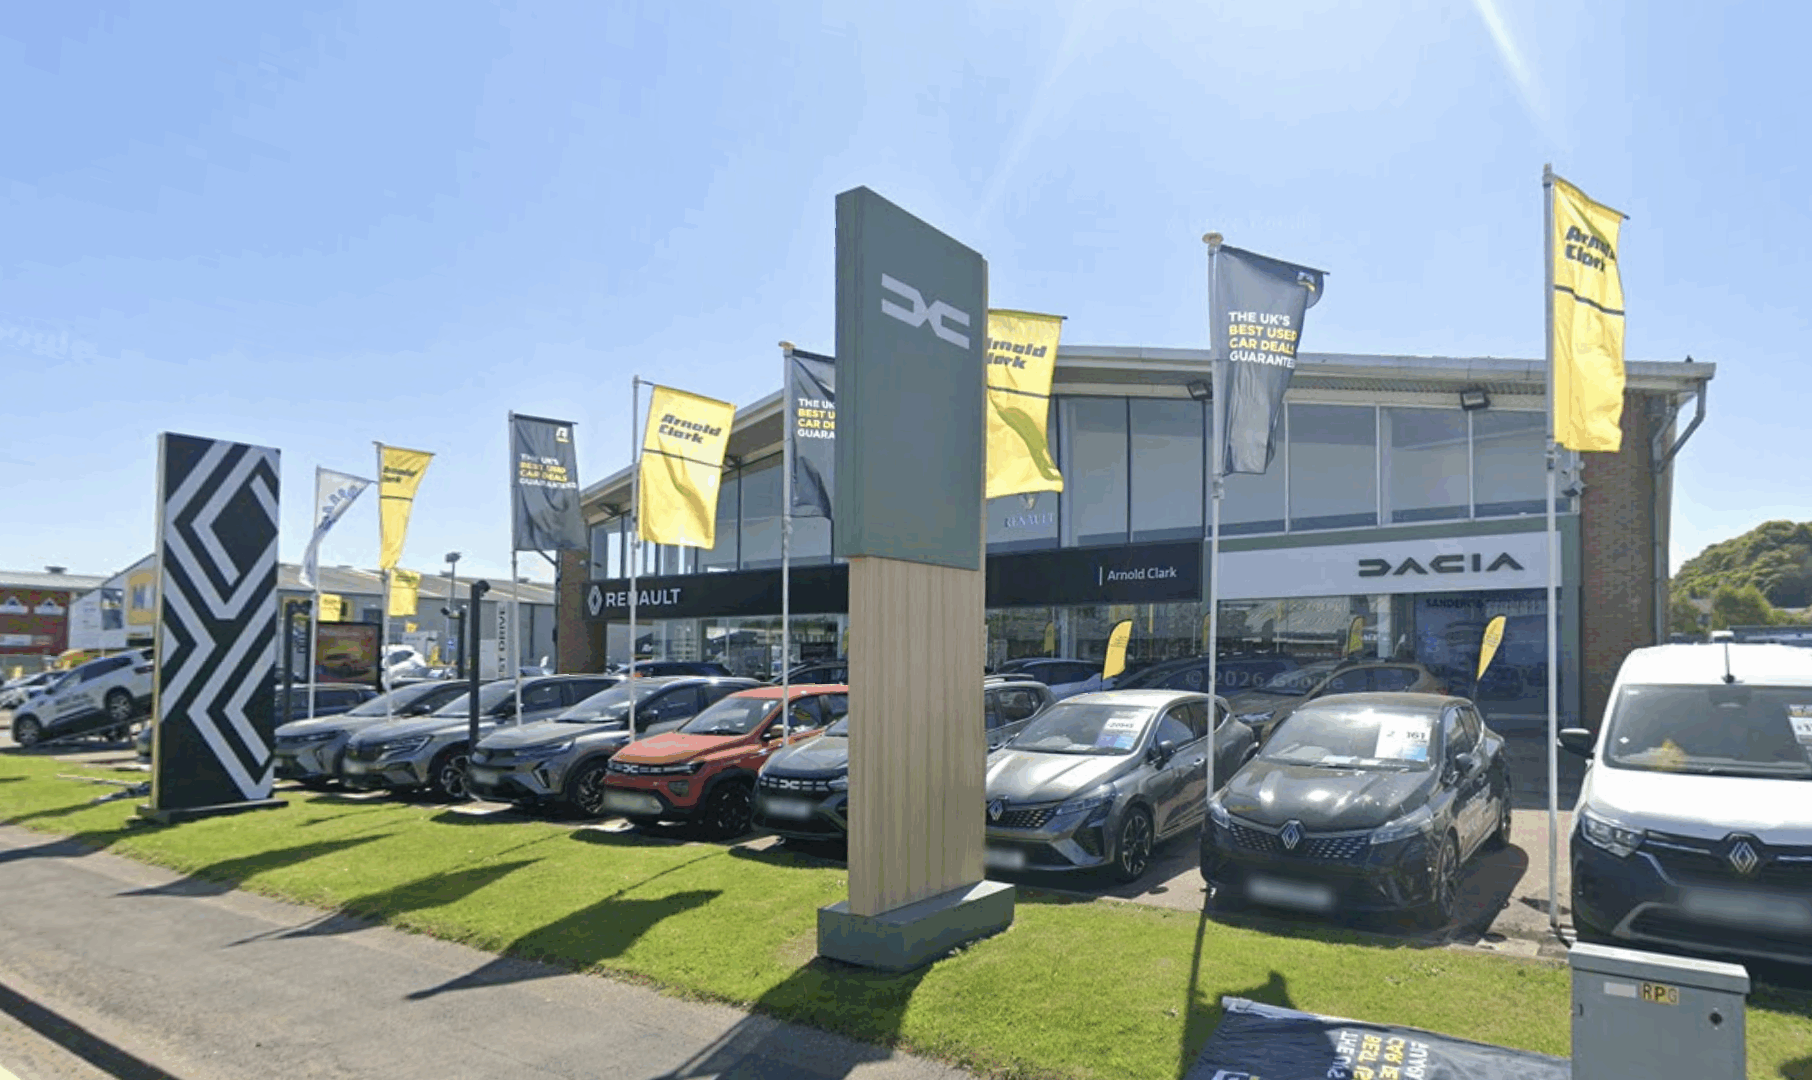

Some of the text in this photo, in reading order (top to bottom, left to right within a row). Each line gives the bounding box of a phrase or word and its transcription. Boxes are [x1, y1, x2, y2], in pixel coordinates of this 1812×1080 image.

[1228, 311, 1290, 326] THE UK'S
[1229, 324, 1263, 337] BEST
[1229, 337, 1258, 349] CAR
[987, 352, 1026, 369] lark
[1229, 350, 1296, 369] GUARANTE
[798, 398, 820, 408] THE
[798, 408, 827, 419] BEST
[661, 413, 722, 437] Arnold
[798, 418, 820, 429] CAR
[659, 424, 704, 444] Clark
[797, 429, 836, 439] GUARA
[1358, 552, 1525, 577] DACIA
[1107, 566, 1178, 580] Arnold Clark
